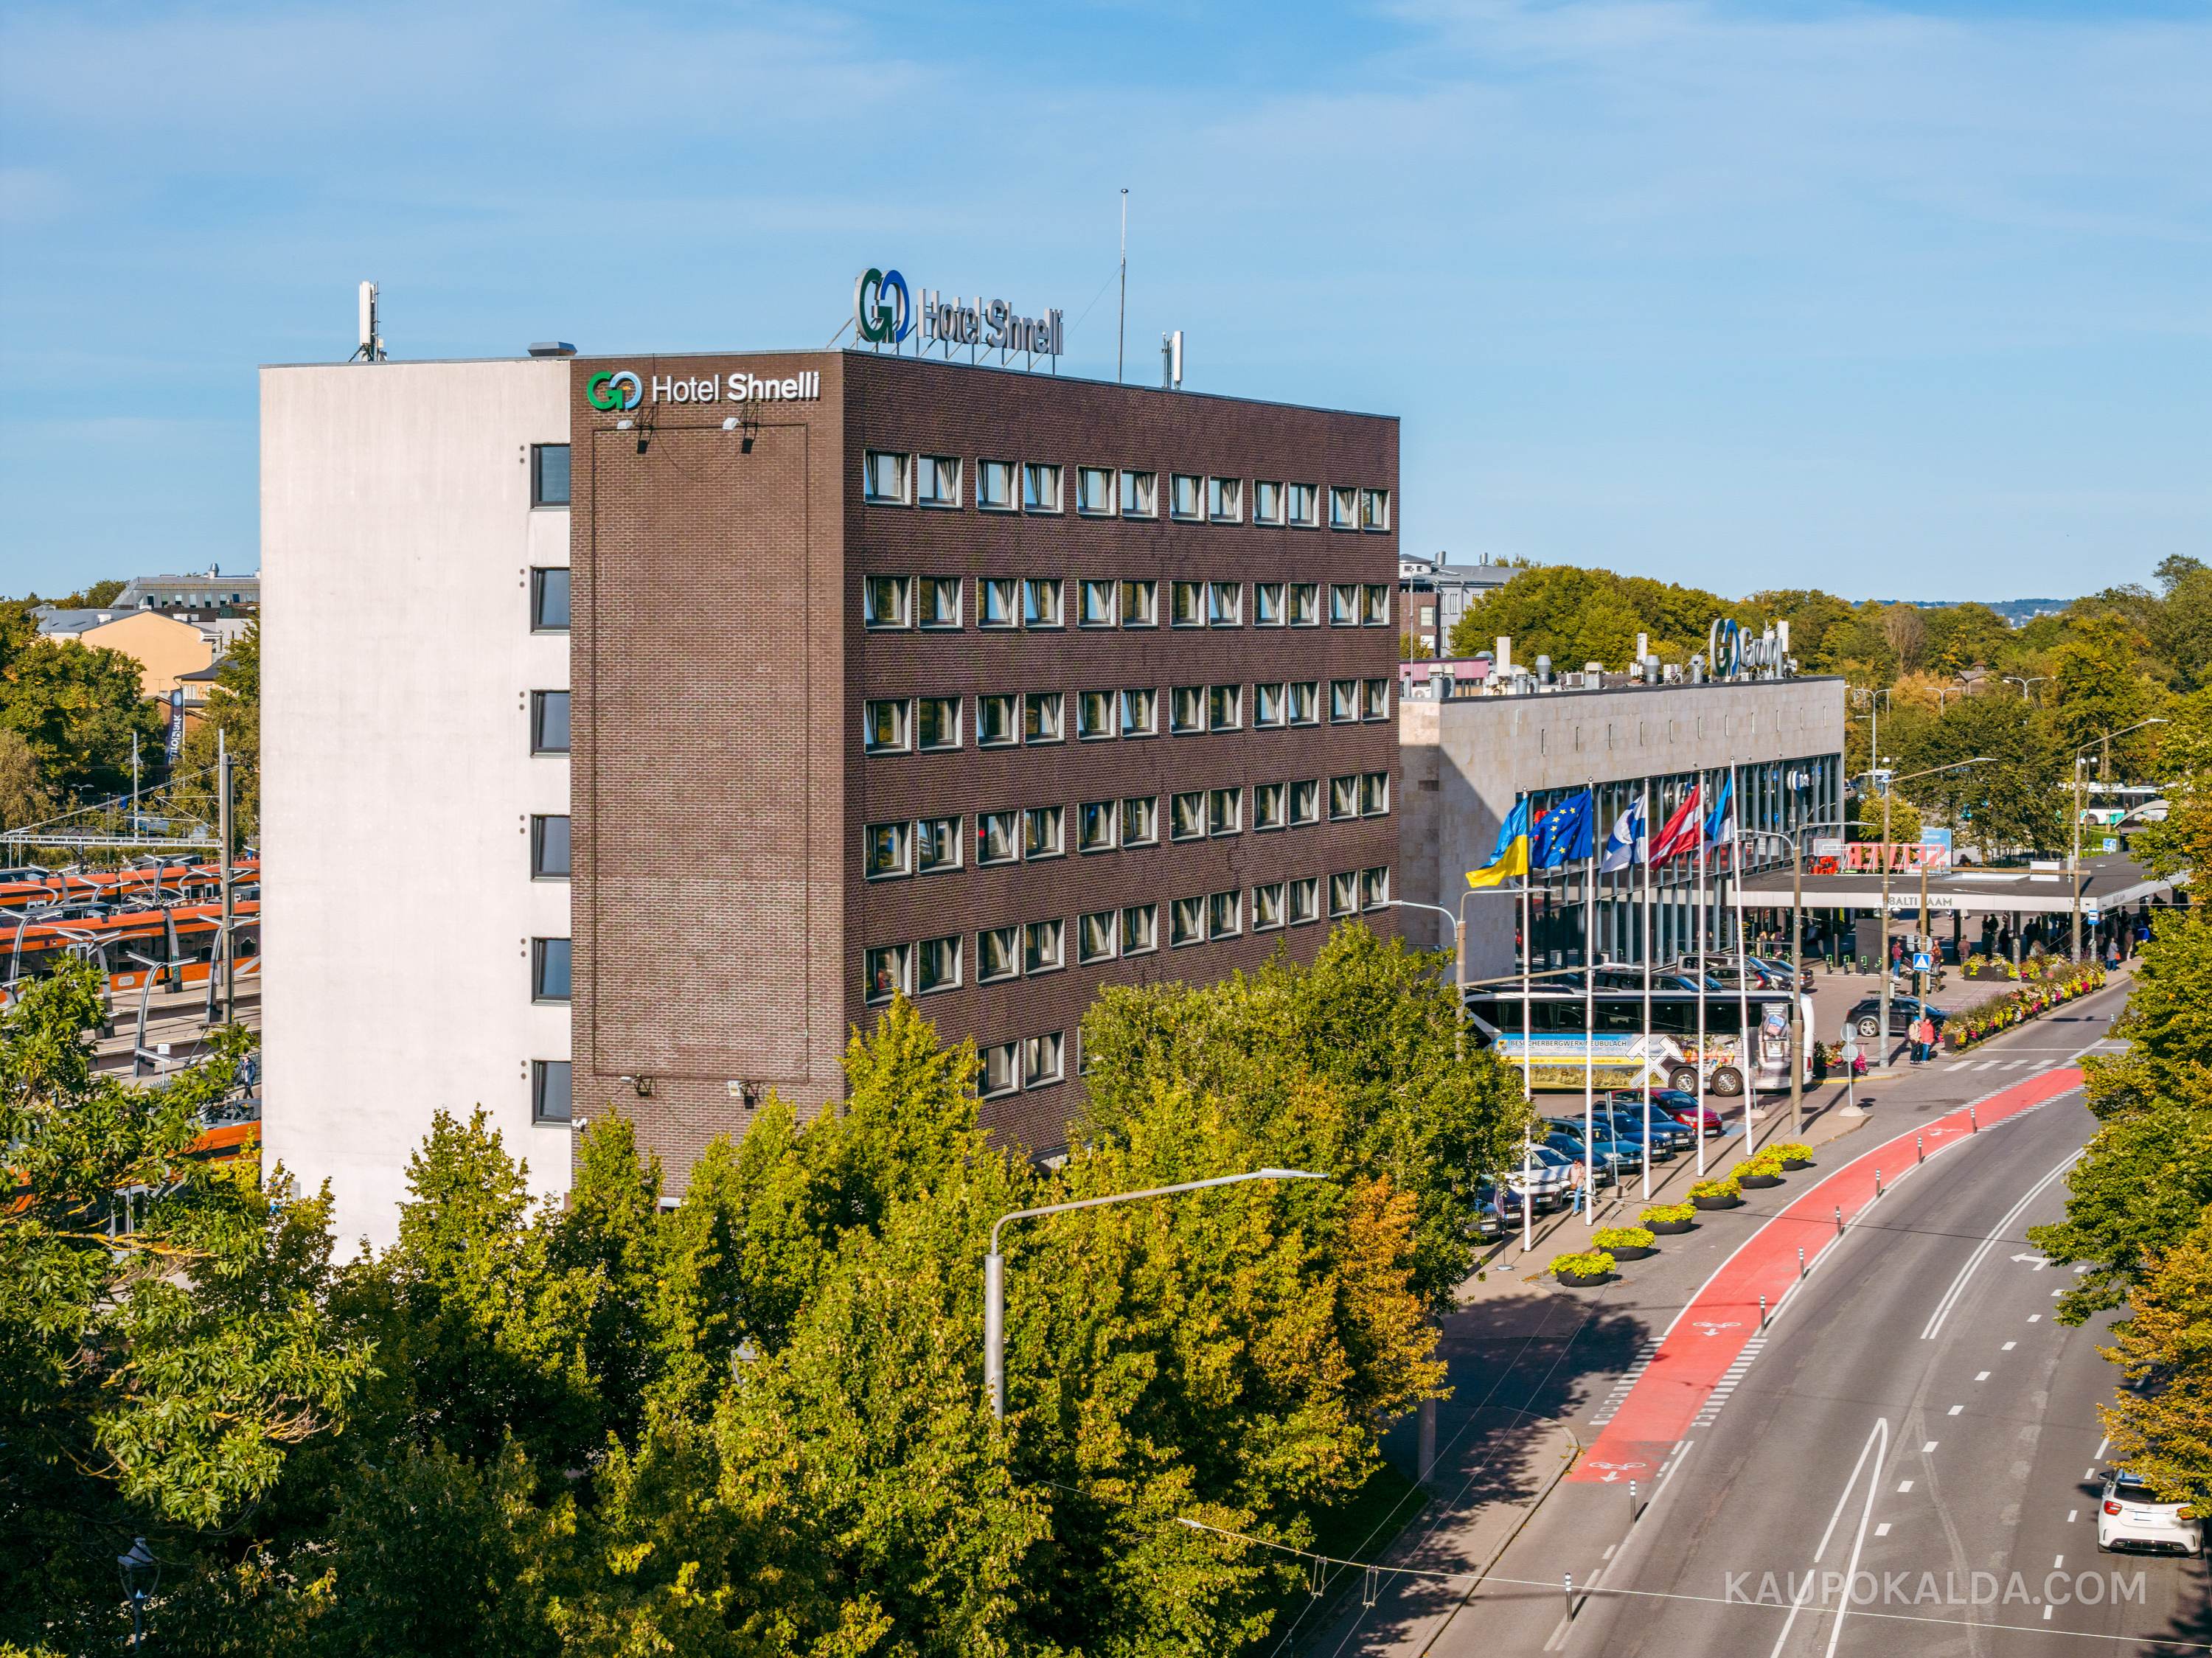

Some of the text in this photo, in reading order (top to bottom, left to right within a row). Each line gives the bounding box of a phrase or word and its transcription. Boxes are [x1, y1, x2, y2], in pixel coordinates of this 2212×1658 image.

[917, 288, 982, 345] Hotel
[986, 299, 1064, 355] Shnelli
[652, 374, 720, 403] Hotel
[728, 371, 821, 402] Shnelli
[1740, 627, 1782, 678] Group
[1888, 896, 1952, 906] BALTI AAM
